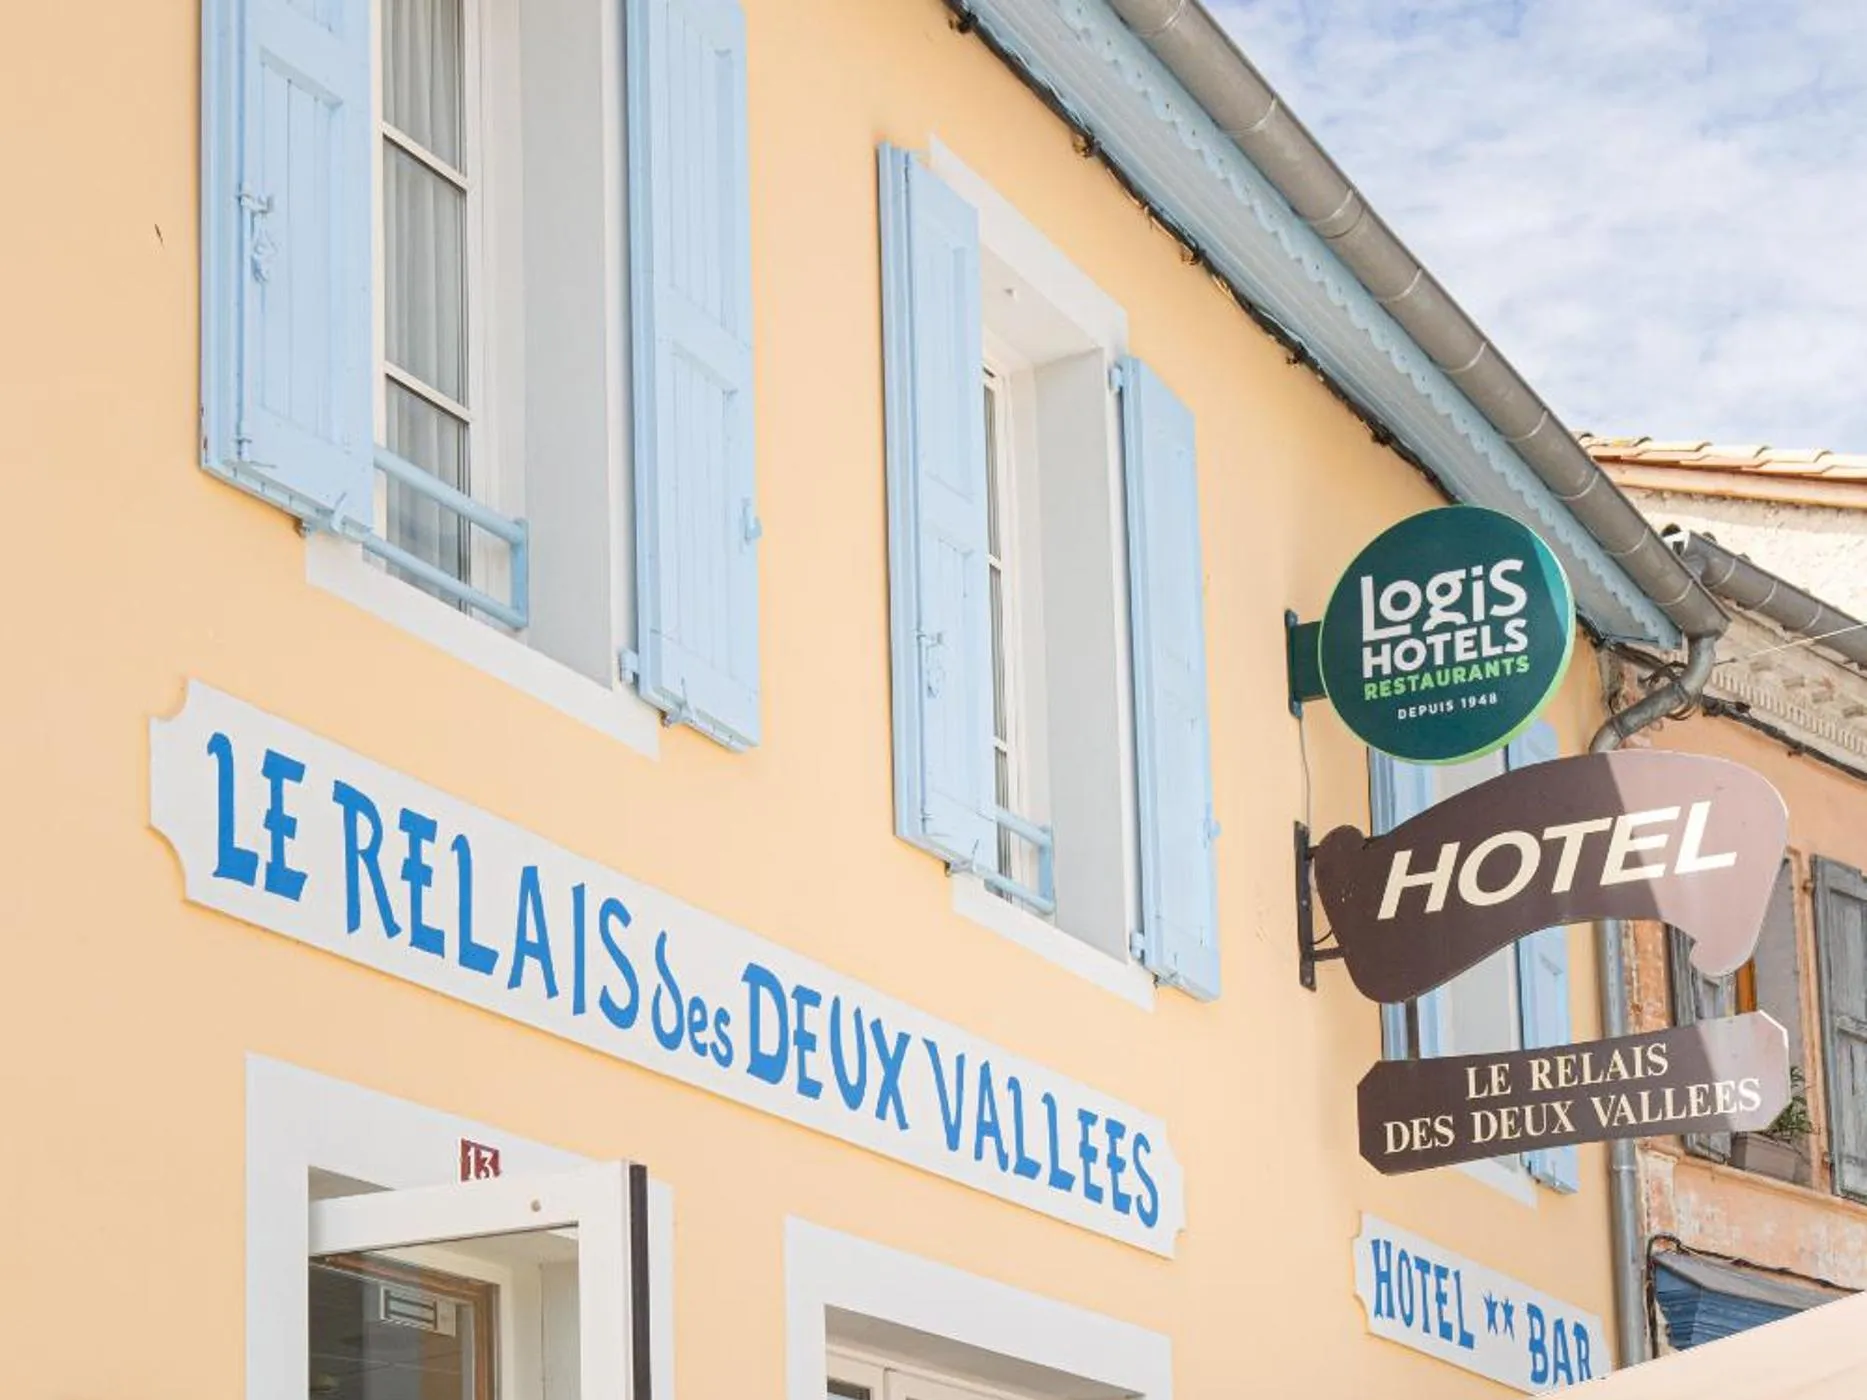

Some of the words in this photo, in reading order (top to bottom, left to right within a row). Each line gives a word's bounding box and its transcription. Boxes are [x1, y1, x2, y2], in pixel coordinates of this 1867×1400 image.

[1362, 618, 1529, 679] HOTELS
[1363, 654, 1530, 701] RESTAURANTS
[1397, 700, 1454, 720] DEPUIS
[1460, 691, 1498, 709] 1948
[1377, 800, 1738, 922] HOTEL
[206, 731, 308, 902] LE
[331, 778, 640, 1030] RELAIS
[651, 930, 734, 1068] des
[740, 961, 912, 1131] DEUX
[922, 1037, 1160, 1229] VALLEES
[1465, 1062, 1512, 1101] LE
[1529, 1041, 1670, 1092] RELAIS
[1383, 1114, 1456, 1155] DES
[1470, 1099, 1577, 1145] DEUX
[1590, 1076, 1763, 1128] VALLEES
[467, 1147, 495, 1180] 13
[1371, 1238, 1475, 1351] HOTEL
[1526, 1302, 1592, 1386] BAR
